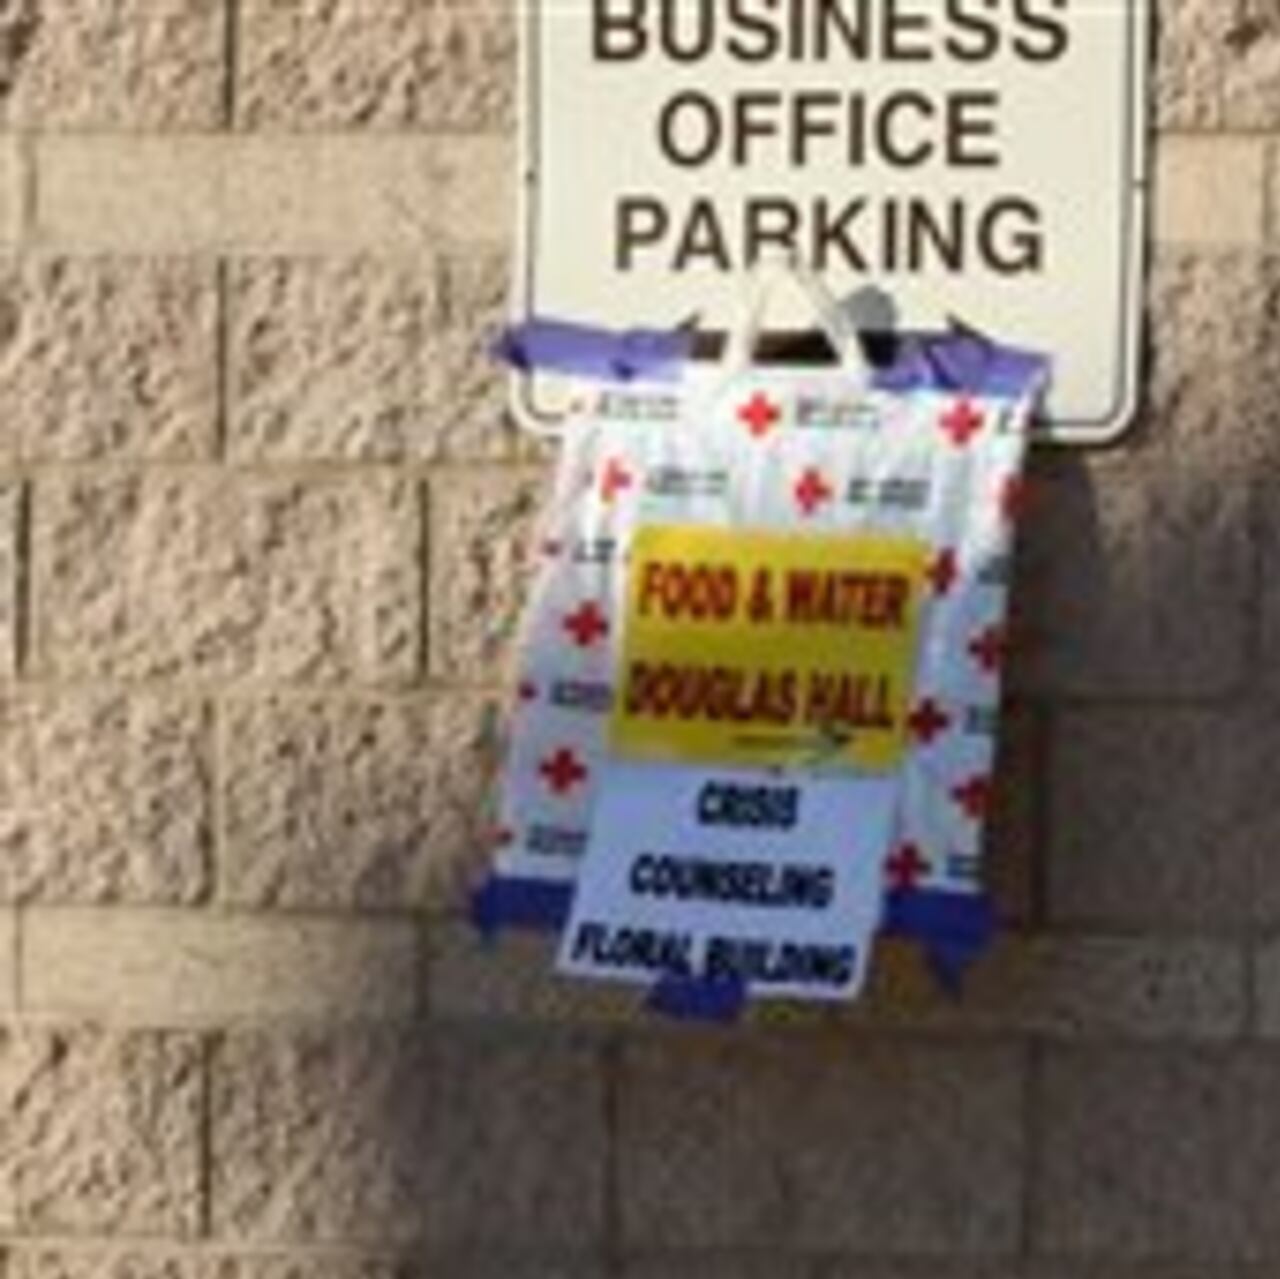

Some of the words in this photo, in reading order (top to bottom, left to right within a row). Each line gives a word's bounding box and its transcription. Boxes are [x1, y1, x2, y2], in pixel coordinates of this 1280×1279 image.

[592, 0, 1070, 63] BUSINESS
[657, 91, 1002, 168] OFFICE
[614, 197, 1044, 274] PARKING
[639, 560, 738, 622] FOOD
[749, 567, 775, 625] &
[786, 568, 911, 631] WATER
[623, 661, 798, 726] DOUGLAS
[800, 665, 894, 730] HALL
[696, 780, 799, 830] CRISIS
[628, 853, 836, 909] COUNSELING
[570, 922, 693, 976] FLORAL
[704, 934, 858, 986] BUILDING
